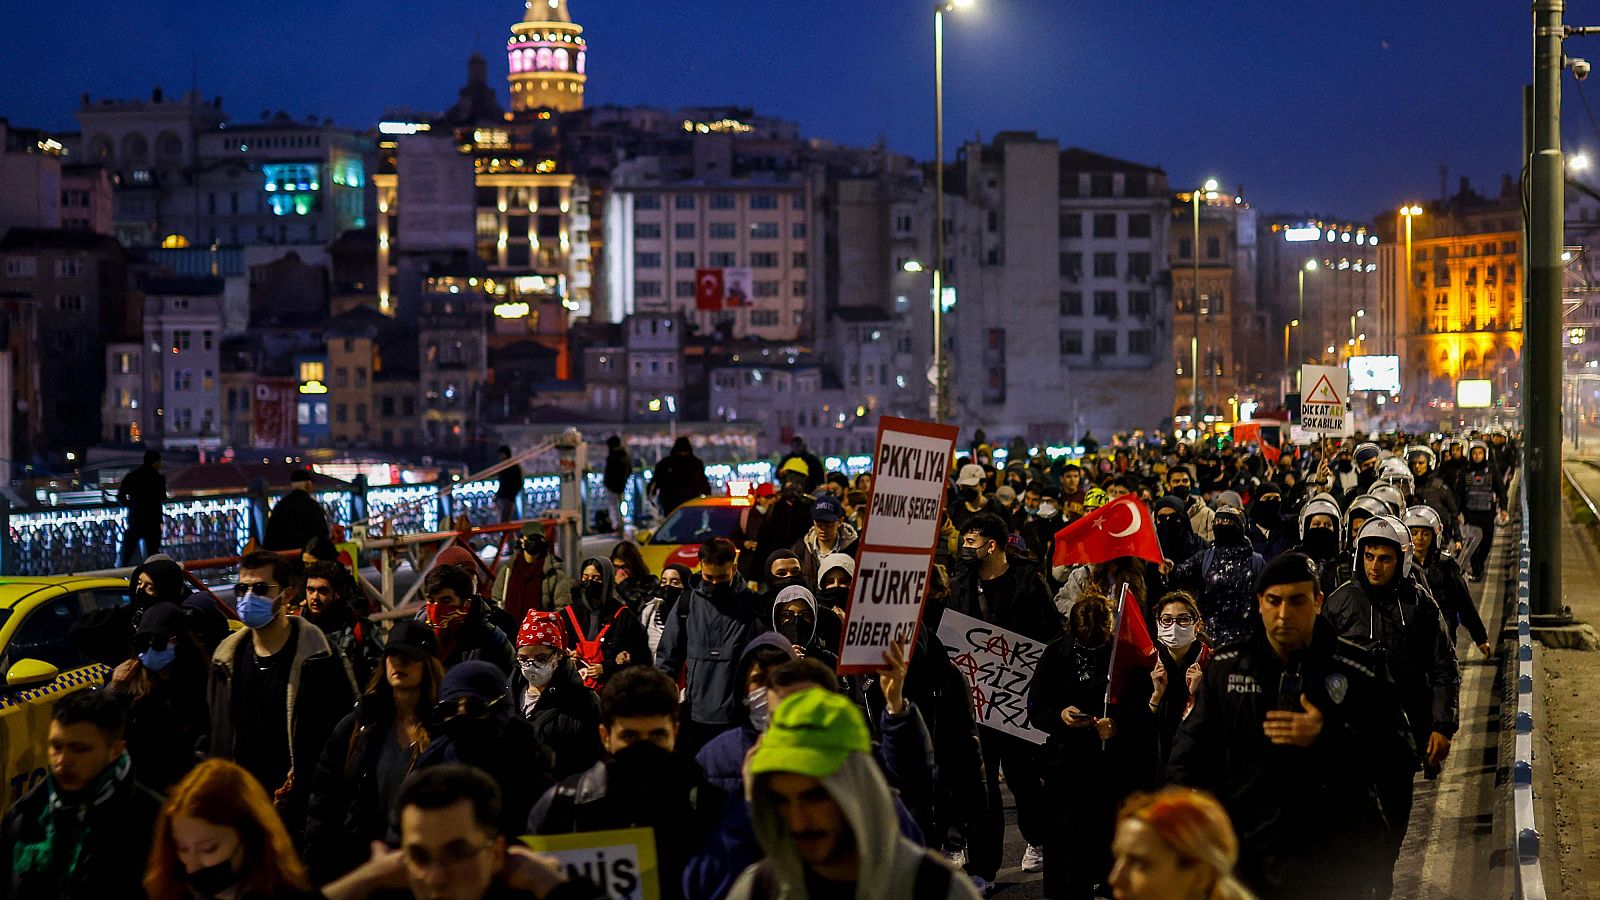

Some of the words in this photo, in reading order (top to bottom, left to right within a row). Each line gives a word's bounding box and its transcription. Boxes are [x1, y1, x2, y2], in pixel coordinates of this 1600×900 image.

[878, 444, 945, 483] PKK'LIYA
[871, 492, 908, 518] PAMUK
[907, 493, 941, 525] ŞEKERİ
[858, 561, 927, 605] TÜRK'E
[845, 615, 891, 647] BİBER
